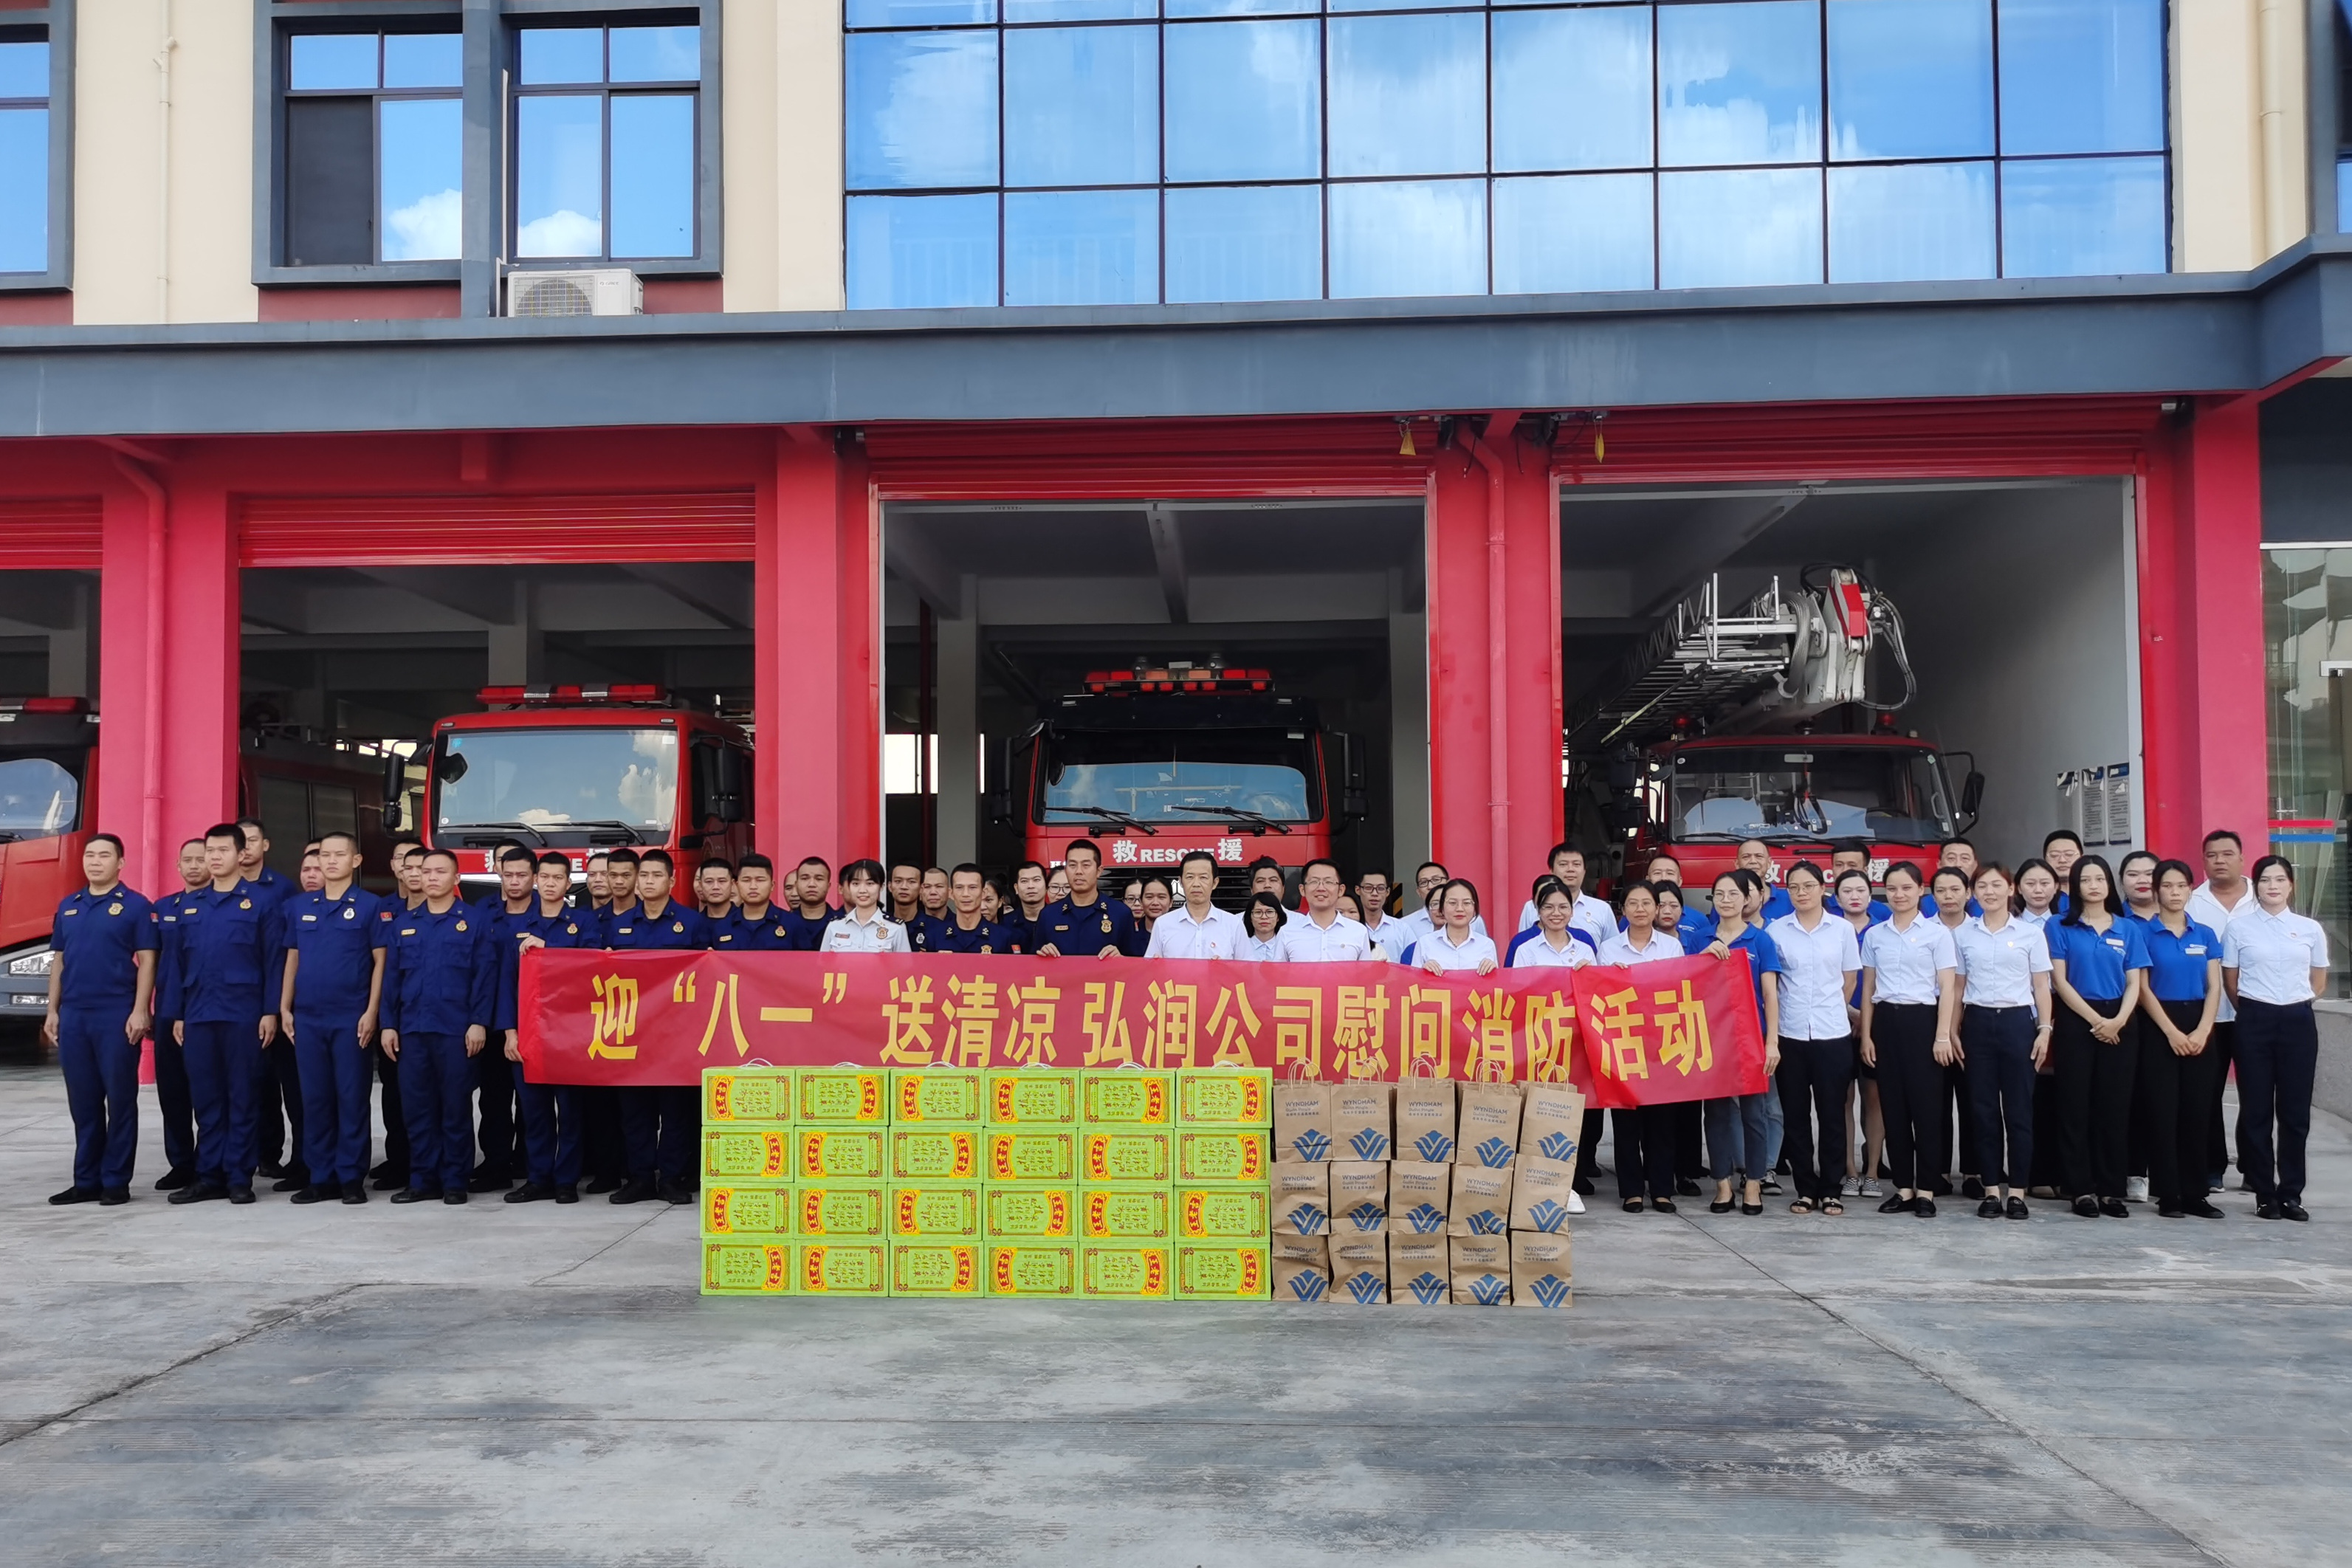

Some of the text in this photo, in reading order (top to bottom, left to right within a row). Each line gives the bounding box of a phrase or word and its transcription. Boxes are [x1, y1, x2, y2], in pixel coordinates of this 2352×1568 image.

[1113, 838, 1242, 863] 救 RESC 援
[716, 1084, 727, 1112] 王老吉
[864, 1084, 876, 1110] 王老吉
[905, 1084, 916, 1112] 王老吉
[1000, 1087, 1011, 1113] 王老吉
[1149, 1086, 1160, 1113] 王老吉
[1247, 1085, 1258, 1113] 王老吉
[1474, 1106, 1507, 1115] WYNDHAM
[1538, 1101, 1572, 1110] WYNDHAM
[769, 1141, 780, 1167] 王老吉
[808, 1141, 819, 1168] 王老吉
[957, 1141, 969, 1169] 王老吉
[998, 1144, 1009, 1171] 王老吉
[1093, 1144, 1104, 1171] 王老吉
[1246, 1144, 1257, 1170] 王老吉
[1467, 1178, 1501, 1189] WYNDHAM
[1527, 1169, 1560, 1177] WYNDHAM
[715, 1197, 726, 1224] 王老吉
[808, 1199, 819, 1225] 王老吉
[901, 1199, 912, 1225] 王老吉
[1052, 1200, 1063, 1226] 王老吉
[1093, 1200, 1104, 1228] 王老吉
[1189, 1200, 1200, 1227] 王老吉
[1285, 1245, 1317, 1253] WYNDHAM
[770, 1254, 781, 1281] 王老吉
[809, 1255, 820, 1282] 王老吉
[959, 1255, 970, 1282] 王老吉
[998, 1256, 1009, 1283] 王老吉
[1149, 1258, 1160, 1285] 王老吉
[1246, 1258, 1257, 1285] 王老吉
